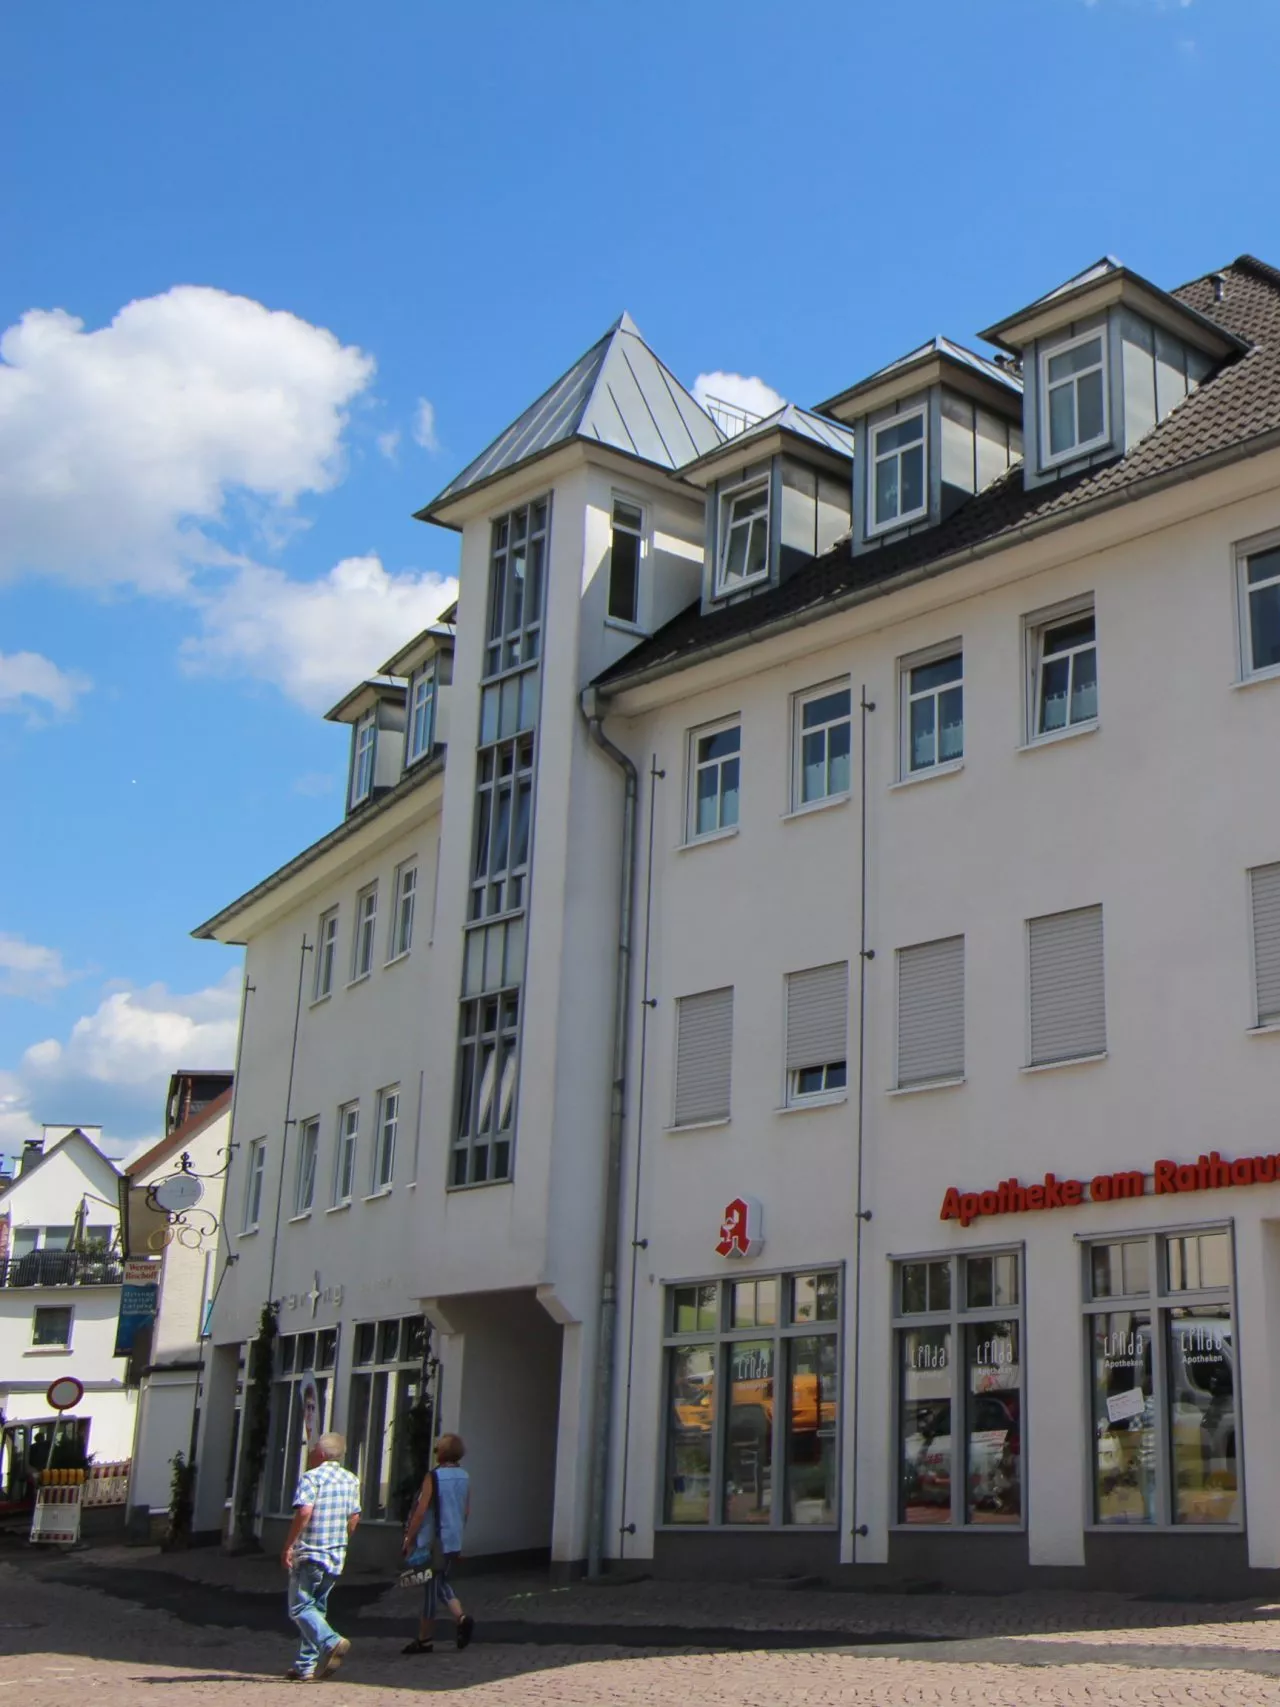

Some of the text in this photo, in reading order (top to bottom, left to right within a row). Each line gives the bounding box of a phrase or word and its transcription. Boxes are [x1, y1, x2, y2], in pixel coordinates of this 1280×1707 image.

[940, 1173, 1084, 1227] Apotheke
[1090, 1170, 1145, 1202] am
[1105, 1359, 1144, 1369] Apotheken
[1182, 1355, 1224, 1365] Apotheken
